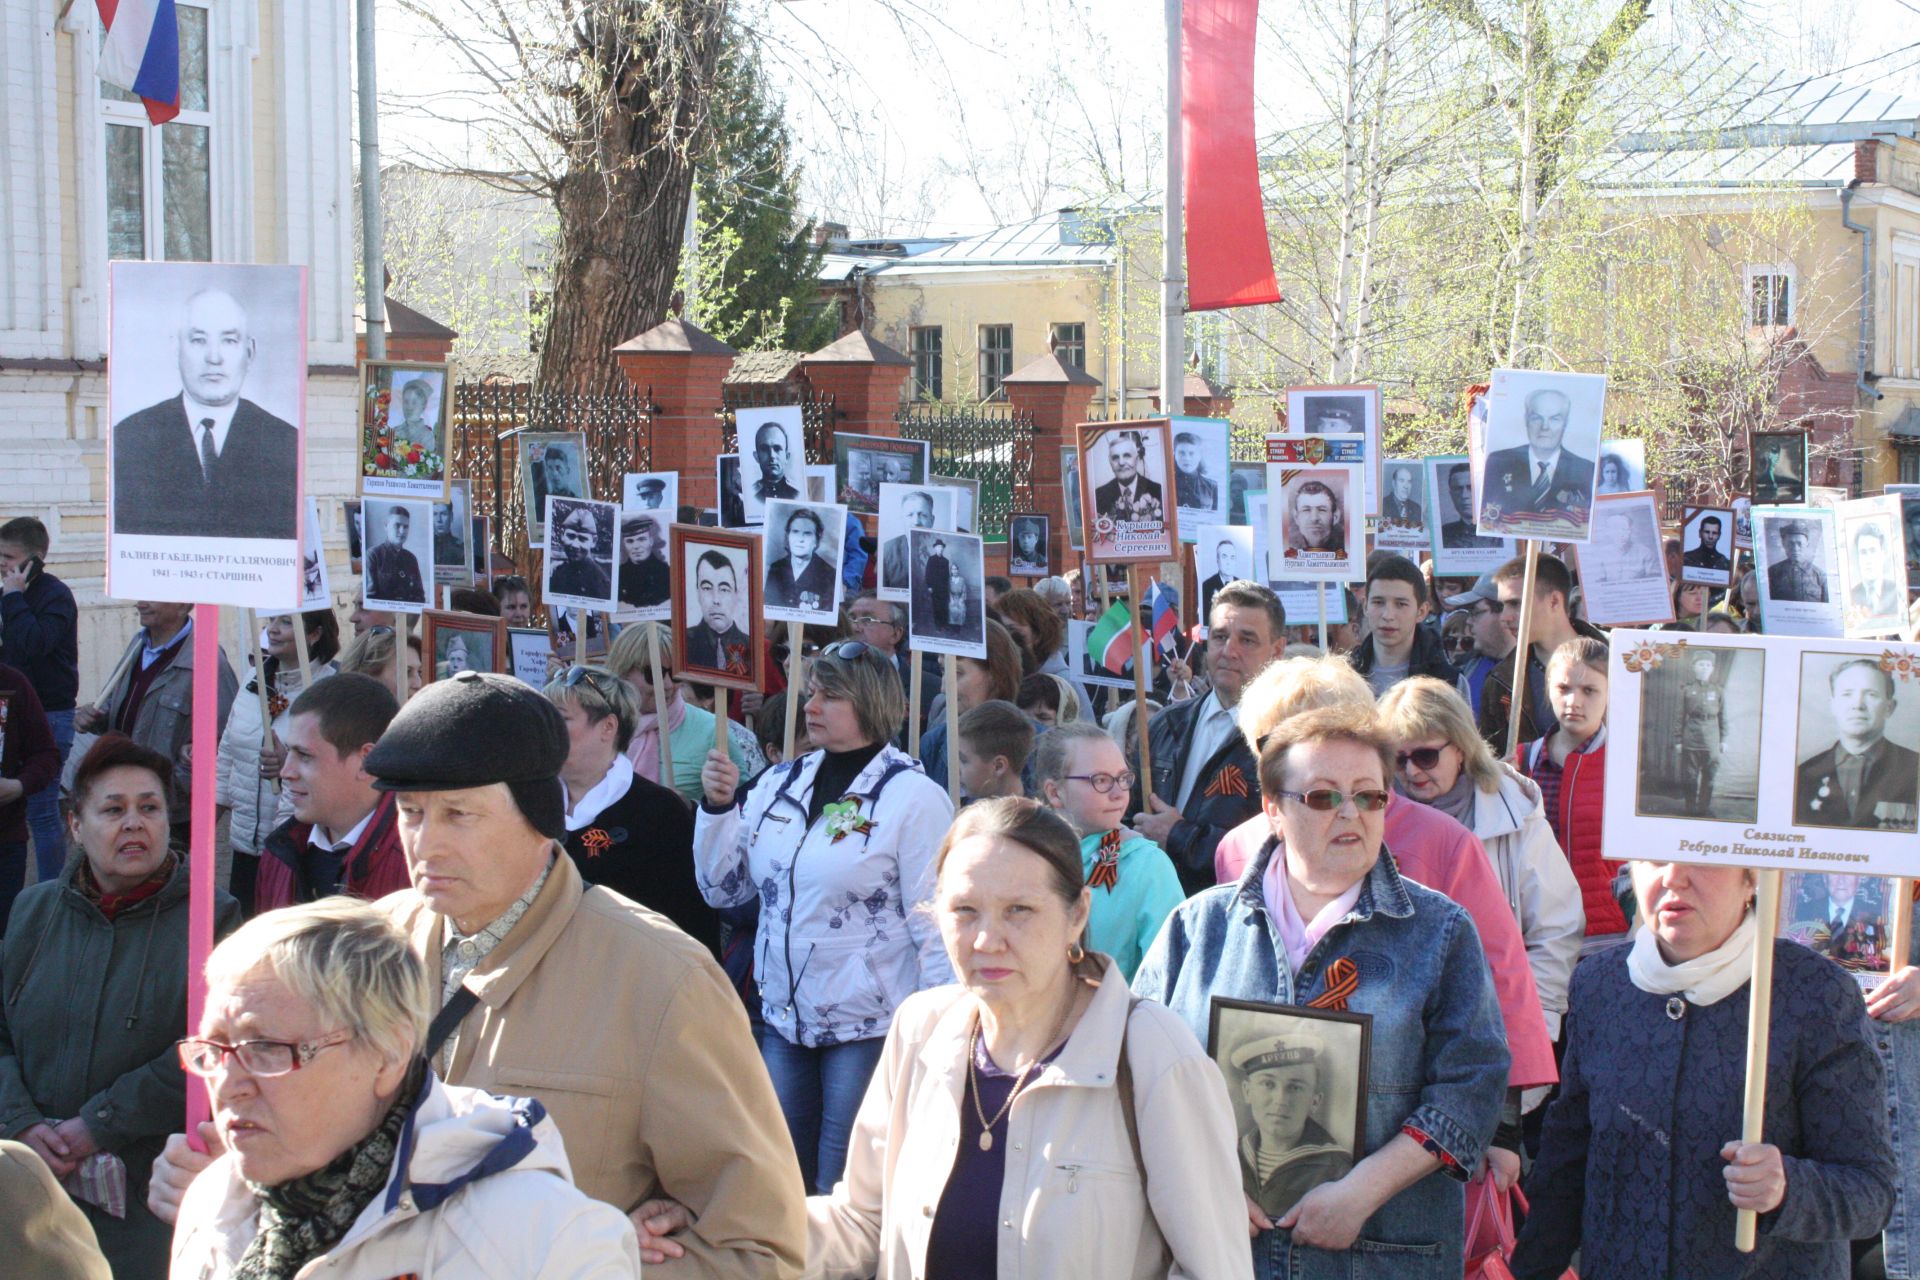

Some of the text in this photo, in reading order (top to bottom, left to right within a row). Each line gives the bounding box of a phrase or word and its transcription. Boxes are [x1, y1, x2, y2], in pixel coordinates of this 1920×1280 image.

[365, 463, 397, 477] 9 МАЯ
[1116, 520, 1162, 531] Курынов
[1116, 531, 1160, 541] Николай
[1114, 544, 1168, 553] Сергеевич
[120, 550, 296, 567] ВАЛИЕВ ГАБДЕЛЬНУР ГАЛЛЯМОВИЧ
[152, 568, 170, 578] 1941
[206, 571, 263, 582] СТАРШИНА
[1743, 828, 1806, 843] Связист
[1679, 839, 1870, 863] Ребров Николай Иванович
